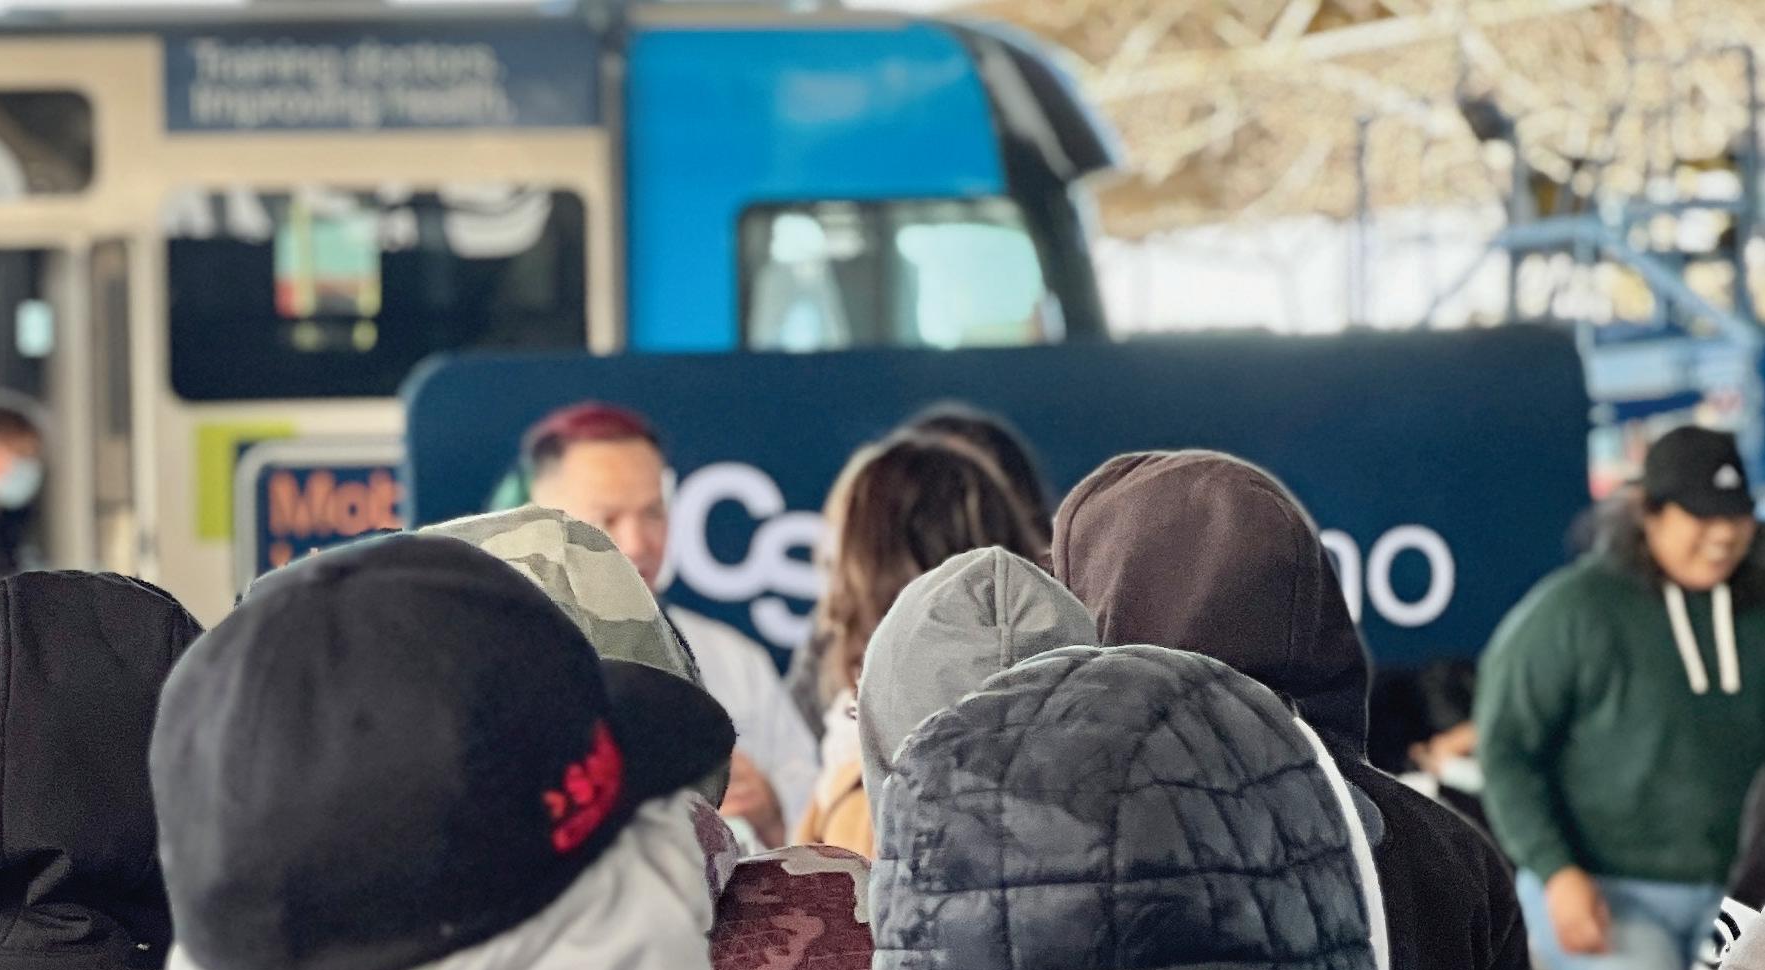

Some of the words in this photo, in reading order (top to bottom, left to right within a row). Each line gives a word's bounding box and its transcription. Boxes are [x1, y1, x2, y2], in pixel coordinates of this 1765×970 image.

[190, 37, 341, 90] Training
[347, 36, 508, 84] doctors.
[190, 83, 383, 130] Improving
